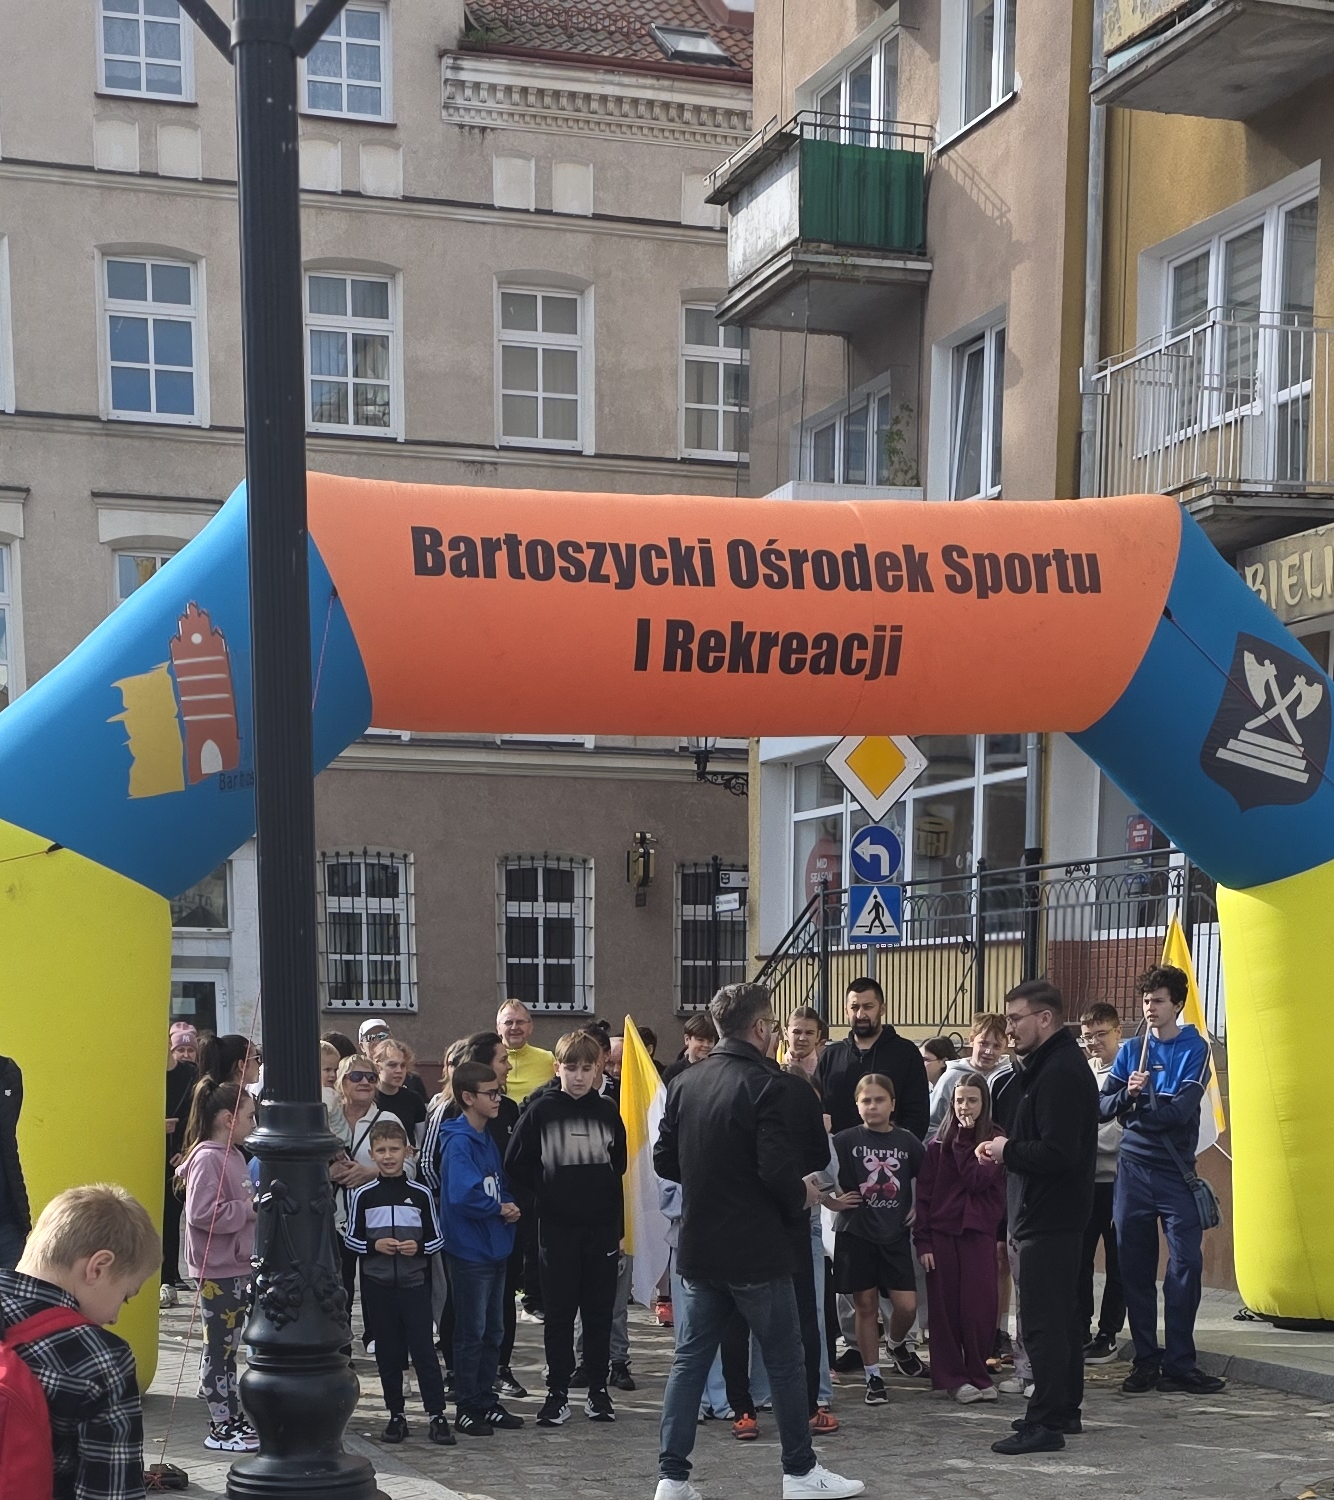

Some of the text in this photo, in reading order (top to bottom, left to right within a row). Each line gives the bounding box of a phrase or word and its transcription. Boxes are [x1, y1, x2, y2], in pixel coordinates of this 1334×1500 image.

[411, 526, 1102, 599] Bartoszycki Ośrodek Sportu
[634, 618, 903, 681] I Rekreacji
[852, 1145, 909, 1159] Cherries
